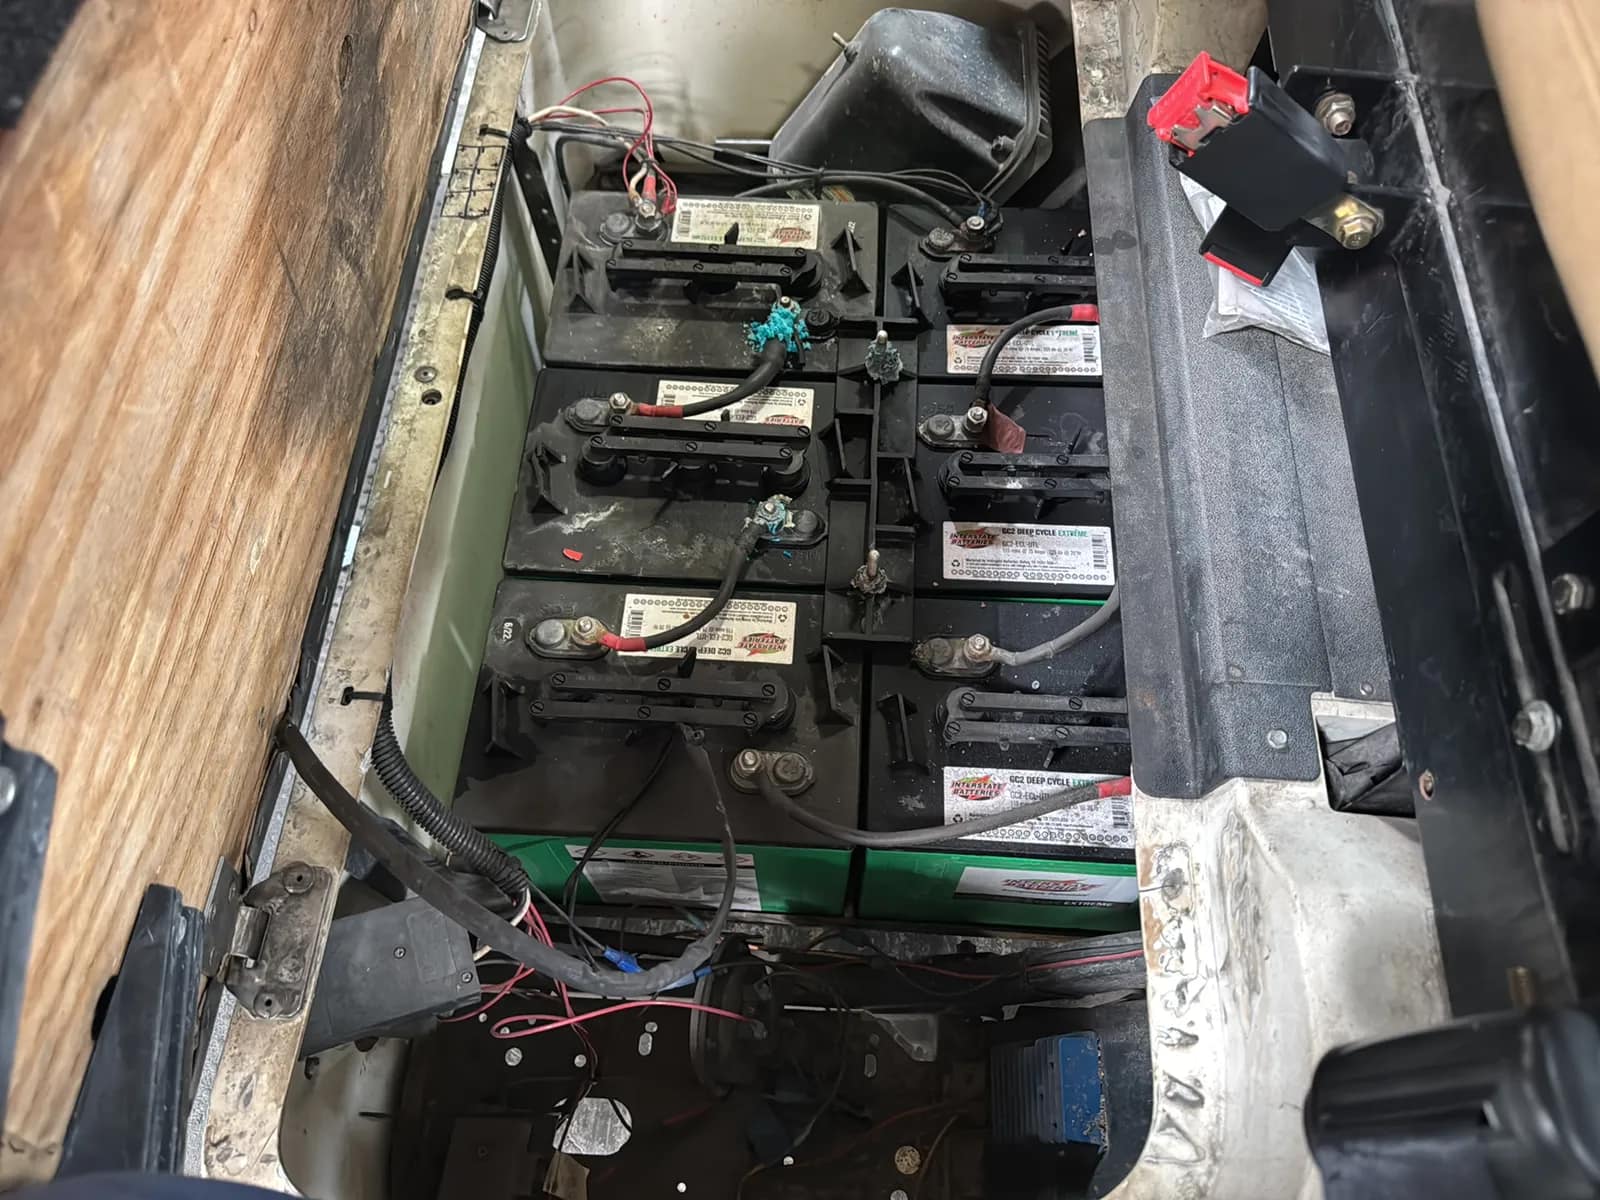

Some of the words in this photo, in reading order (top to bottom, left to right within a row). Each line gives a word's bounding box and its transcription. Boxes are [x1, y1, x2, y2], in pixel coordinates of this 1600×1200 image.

[949, 532, 997, 540] INTERSTATE
[1001, 527, 1016, 535] GC2
[1016, 528, 1035, 536] DEEP
[1035, 529, 1056, 537] CYCLE
[502, 622, 514, 640] 6/22
[742, 636, 786, 645] BATTERIES
[697, 646, 716, 655] DEEP
[717, 647, 732, 656] GC2
[741, 642, 787, 652] INTERSTATE
[951, 781, 1002, 790] INTERSTATE
[1009, 775, 1025, 784] GC2
[1026, 776, 1046, 785] DEEP
[1047, 777, 1070, 787] CYCLE
[952, 788, 1000, 796] BATTERIES
